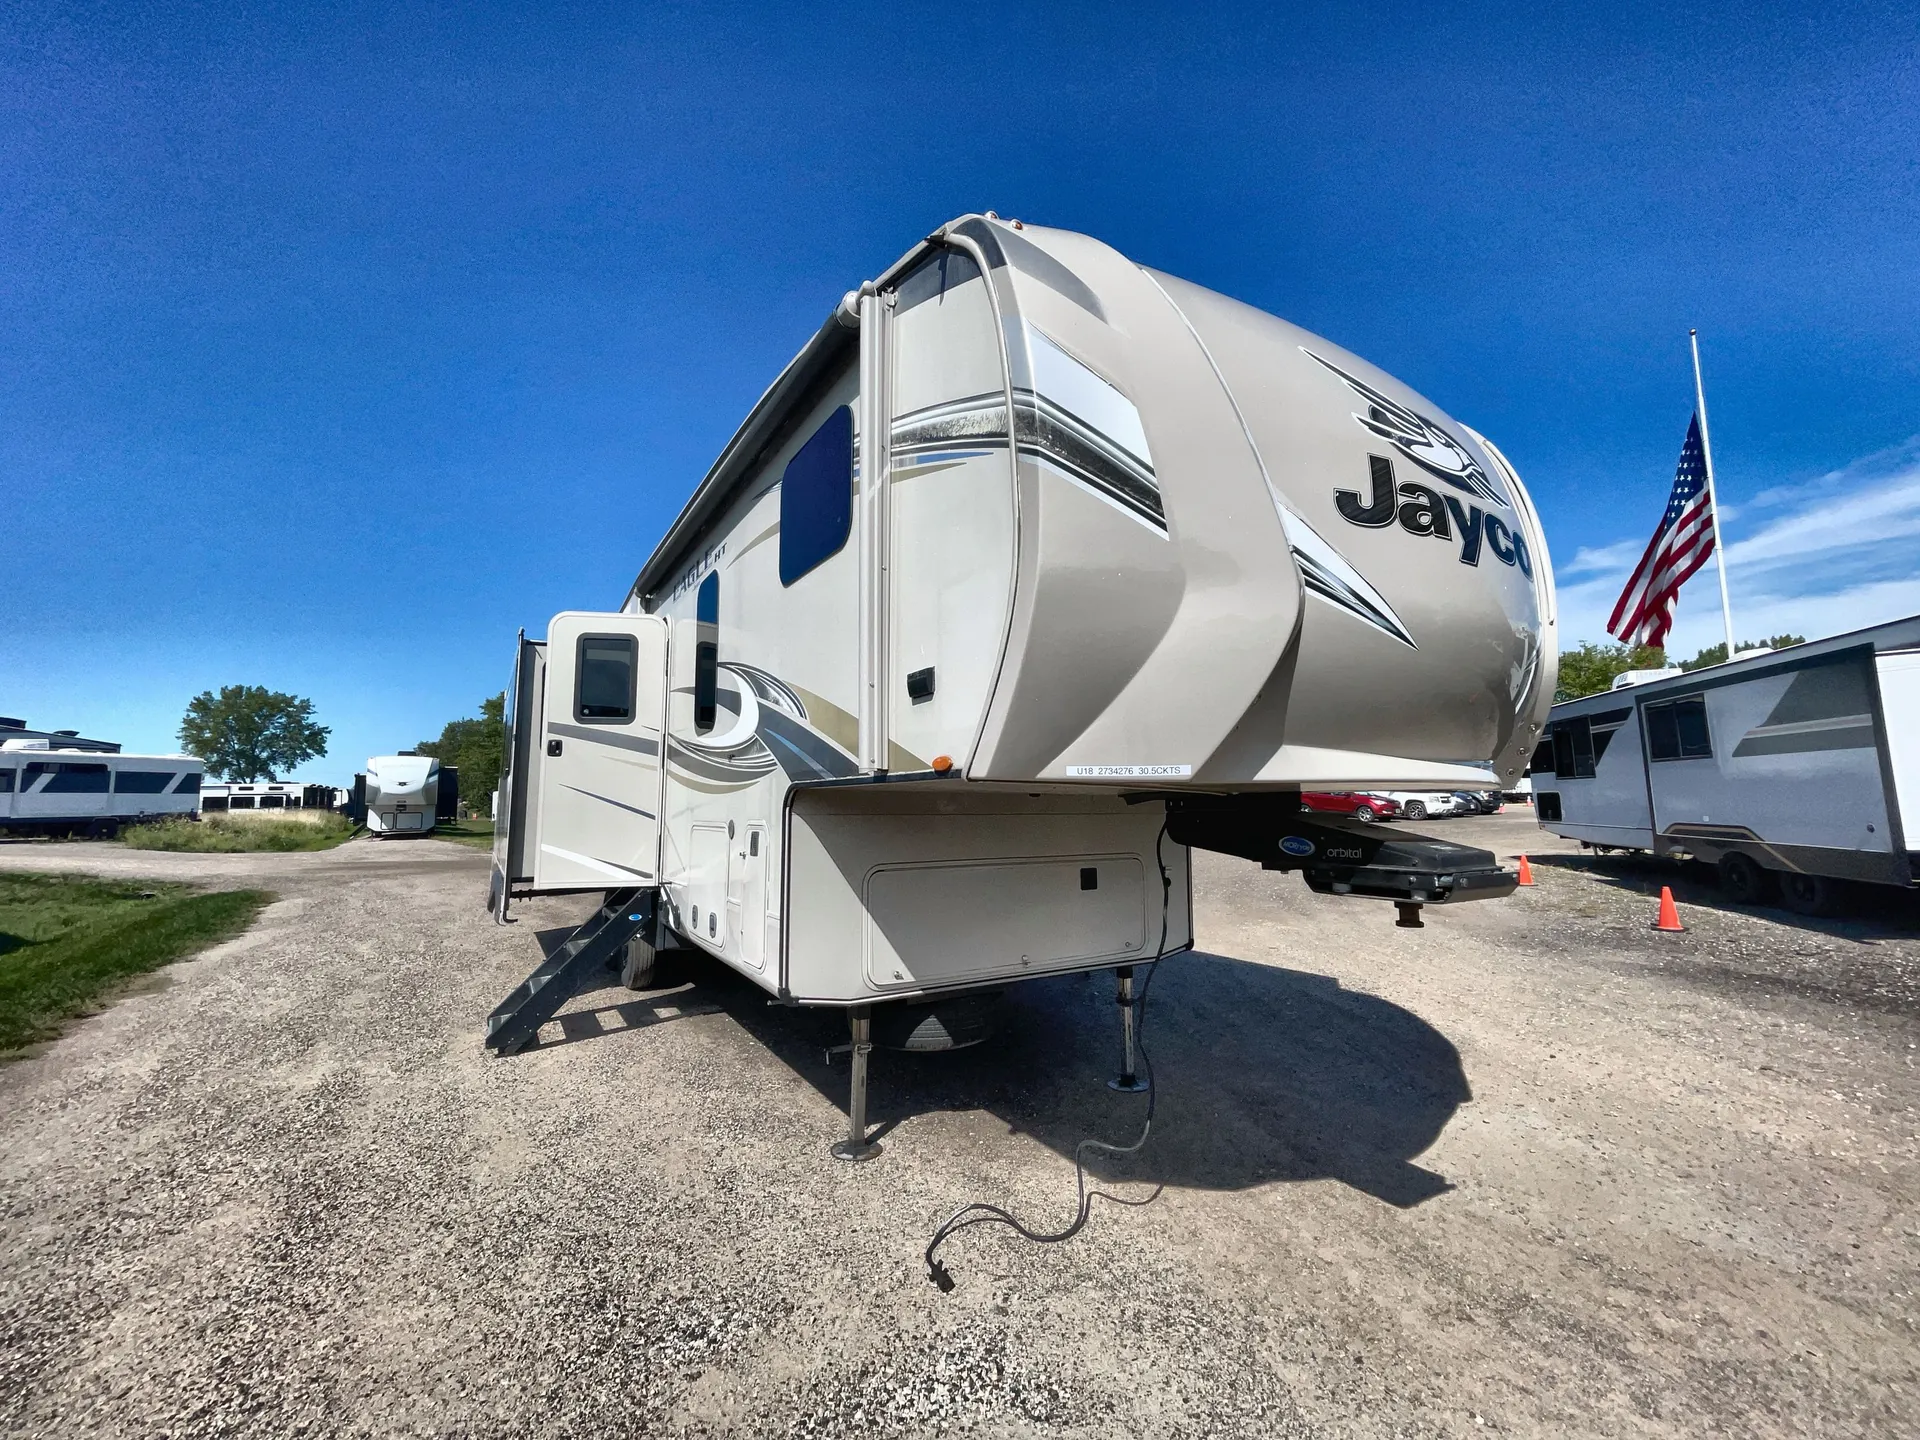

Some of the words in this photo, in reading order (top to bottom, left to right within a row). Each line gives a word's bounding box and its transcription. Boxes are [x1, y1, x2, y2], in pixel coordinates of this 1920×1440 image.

[1333, 452, 1533, 583] Jayco
[672, 544, 714, 604] EAGLE
[714, 542, 727, 562] HT
[1077, 767, 1094, 775] U18
[1098, 767, 1134, 775] 2734276
[1138, 766, 1181, 775] 30.5CKTS
[1327, 848, 1362, 858] orbital
